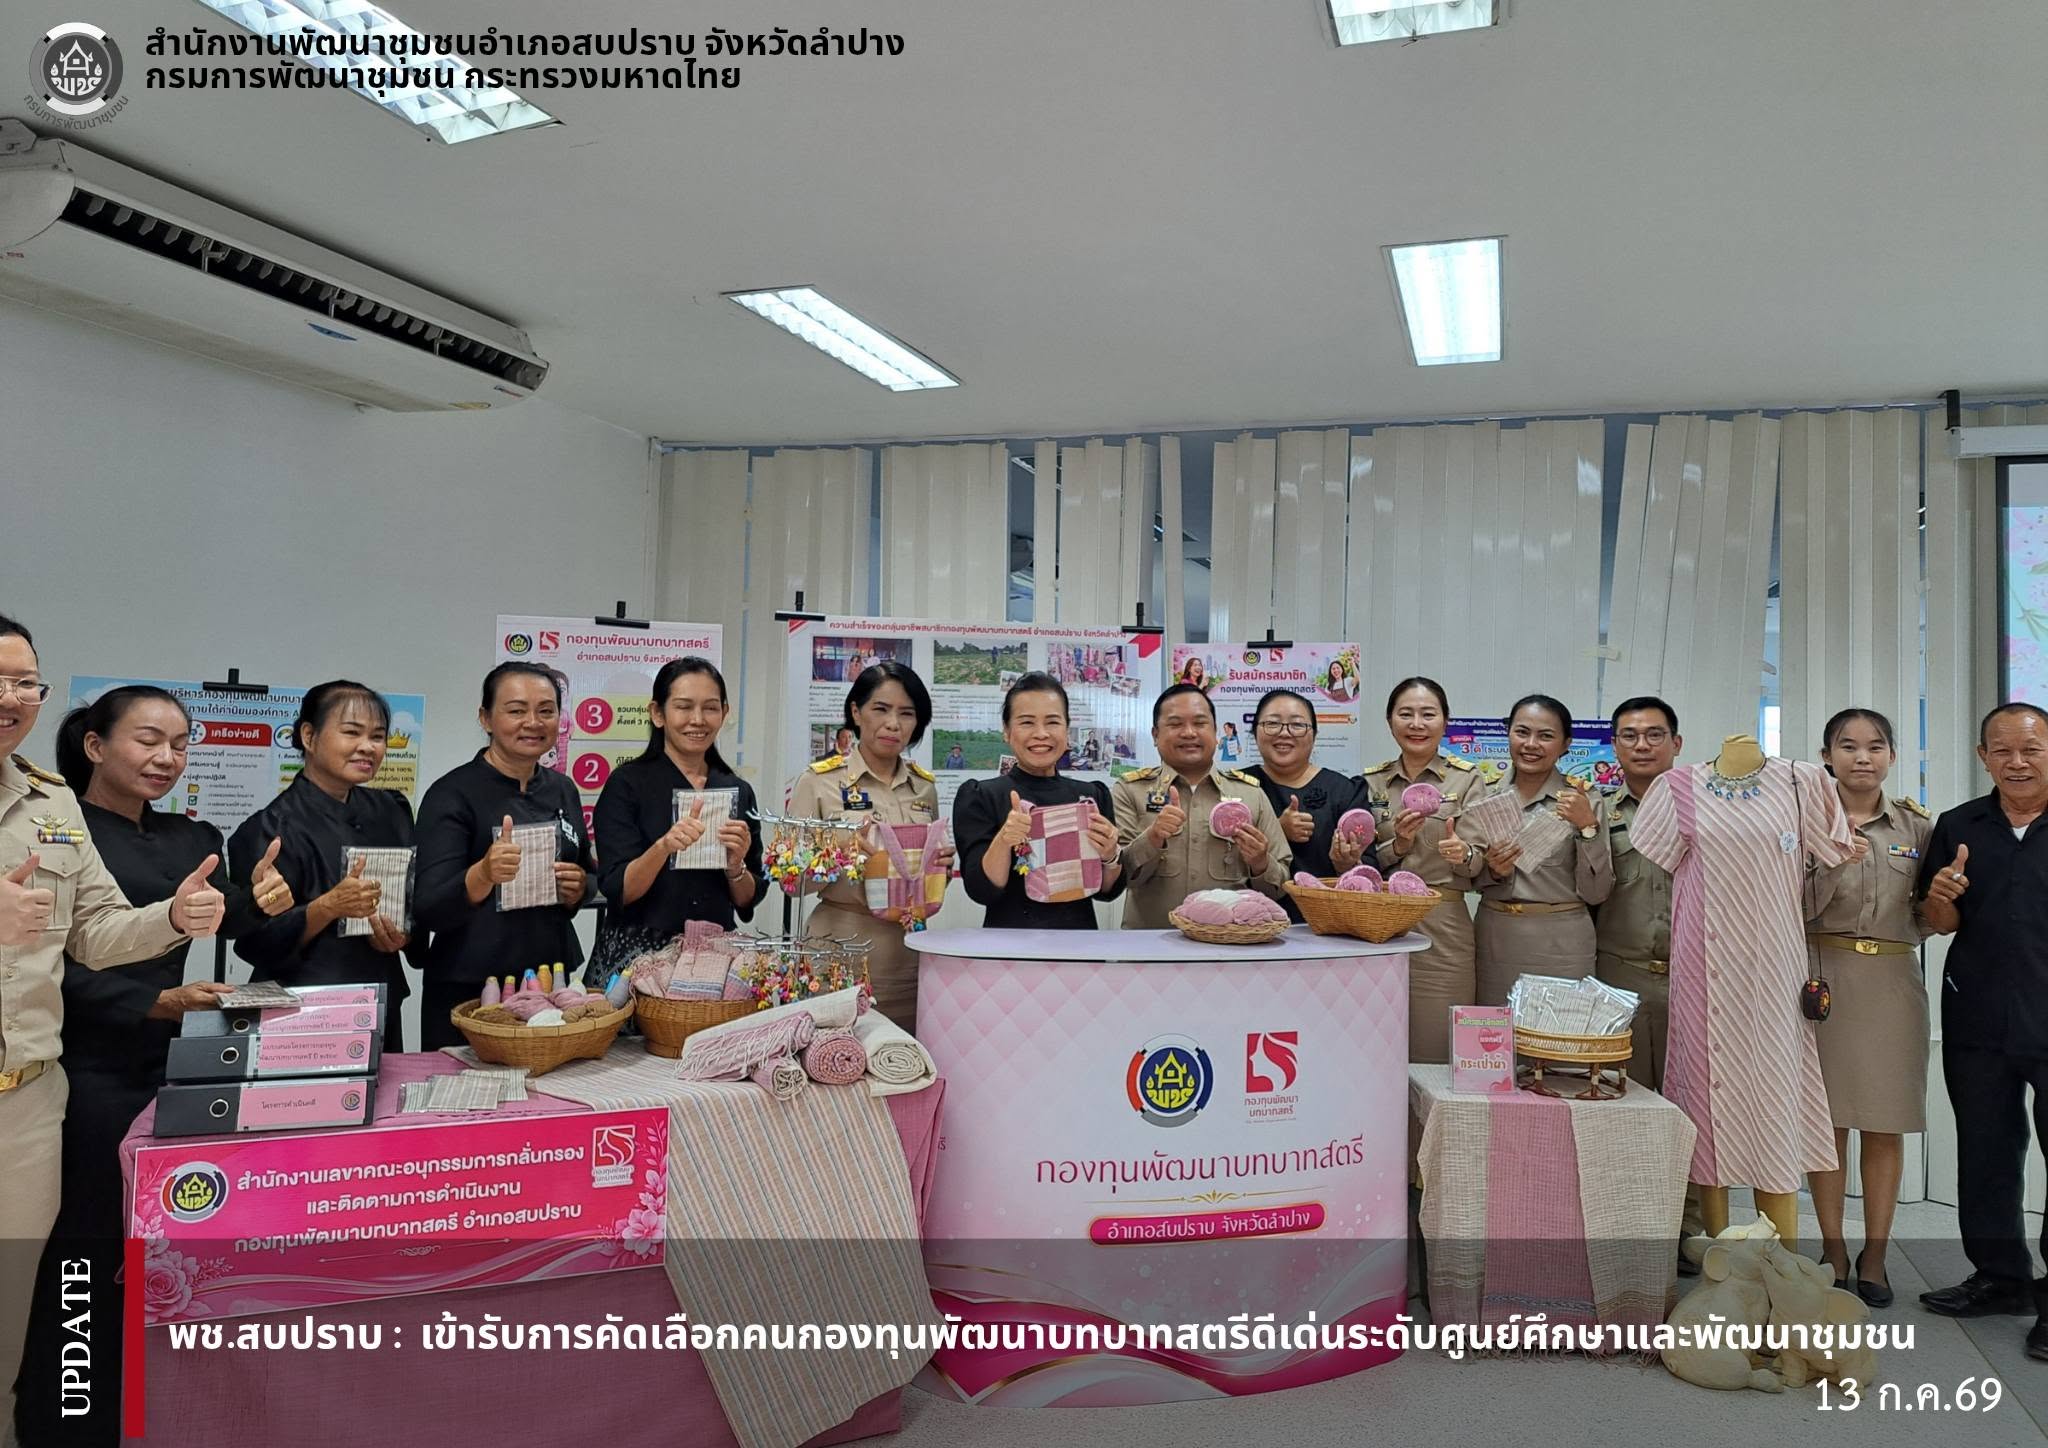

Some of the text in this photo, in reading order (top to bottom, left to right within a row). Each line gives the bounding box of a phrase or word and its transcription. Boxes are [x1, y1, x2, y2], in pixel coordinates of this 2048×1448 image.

[566, 633, 710, 649] กองทุนพัฒนาบทบาทสตรี
[576, 651, 641, 663] อำเภอสบปราบ
[1228, 668, 1307, 681] รับสมัครสมาชิก
[586, 703, 604, 728] 3
[210, 727, 261, 740] เครือข่ายดี
[1461, 743, 1471, 754] 3
[1473, 743, 1482, 753] ดี
[583, 759, 599, 783] 2
[1244, 1094, 1299, 1108] กองทุนพัฒนา
[1249, 1104, 1294, 1117] บทบาทสตรี
[237, 1142, 585, 1191] สำนักงานเลขาคณะอนุกรรมการกลั่นกรอง
[1036, 1133, 1364, 1194] กองทุนพัฒนาบทบาทสตรี
[306, 1180, 522, 1216] และติดตามการดำเนินงาน
[235, 1203, 582, 1254] กองทุนพัฒนาบทบาทสตรี อำเภอสบปราบ
[1107, 1208, 1310, 1240] อำเภอสบปราบ จังหวัดลำปาง
